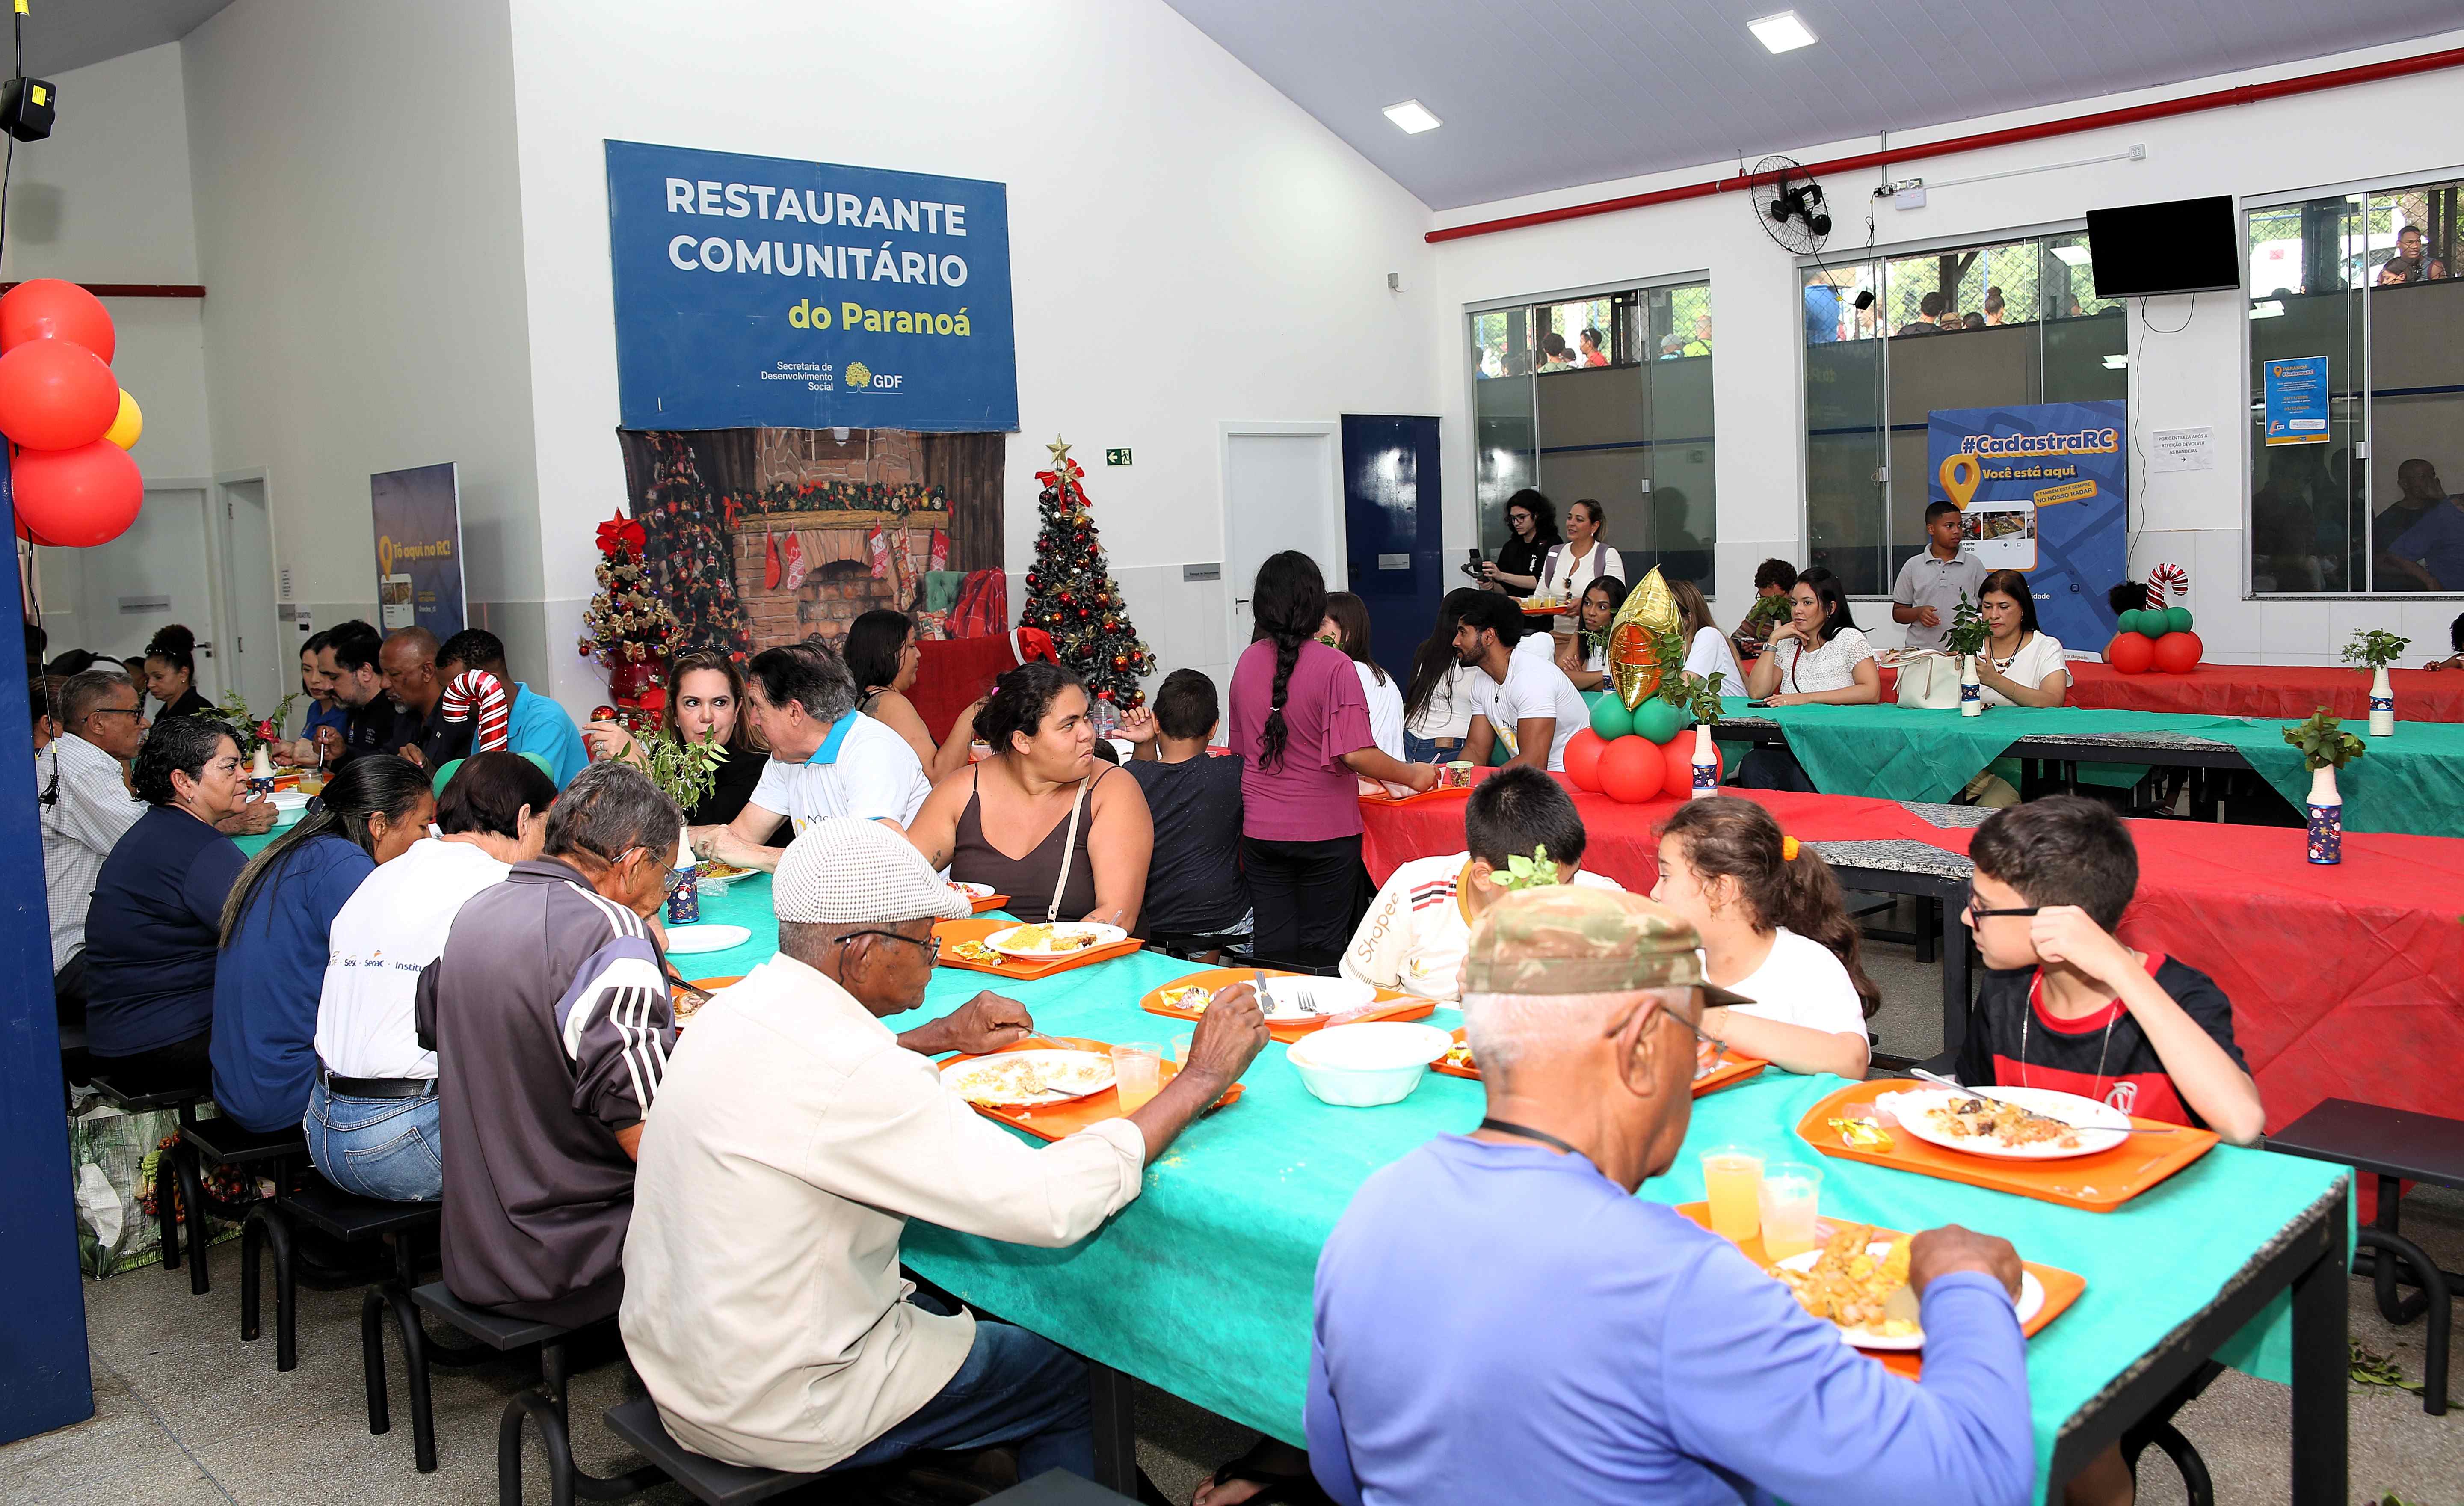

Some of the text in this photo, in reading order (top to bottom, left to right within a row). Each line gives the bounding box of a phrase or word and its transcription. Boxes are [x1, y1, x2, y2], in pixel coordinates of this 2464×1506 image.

[666, 177, 967, 237] RESTAURANTE
[668, 235, 968, 287] COMUNITÁRIO
[788, 298, 971, 336] do Paranoá
[777, 361, 832, 371] Secretaria de
[761, 371, 833, 381] Desenvolvimento
[873, 374, 903, 388] GDF
[808, 382, 834, 391] Social
[1962, 428, 2116, 455] #CadastraRC
[1982, 465, 2076, 480] Você está aqui
[2072, 482, 2091, 490] SEMPRE
[2047, 492, 2069, 501] NOSSO
[2070, 487, 2092, 497] RADAR
[404, 541, 424, 560] aqui
[424, 545, 435, 556] no
[436, 540, 452, 556] RC!
[1357, 892, 1399, 963] Shopee
[364, 959, 384, 967] Senac
[395, 961, 423, 972] Institu
